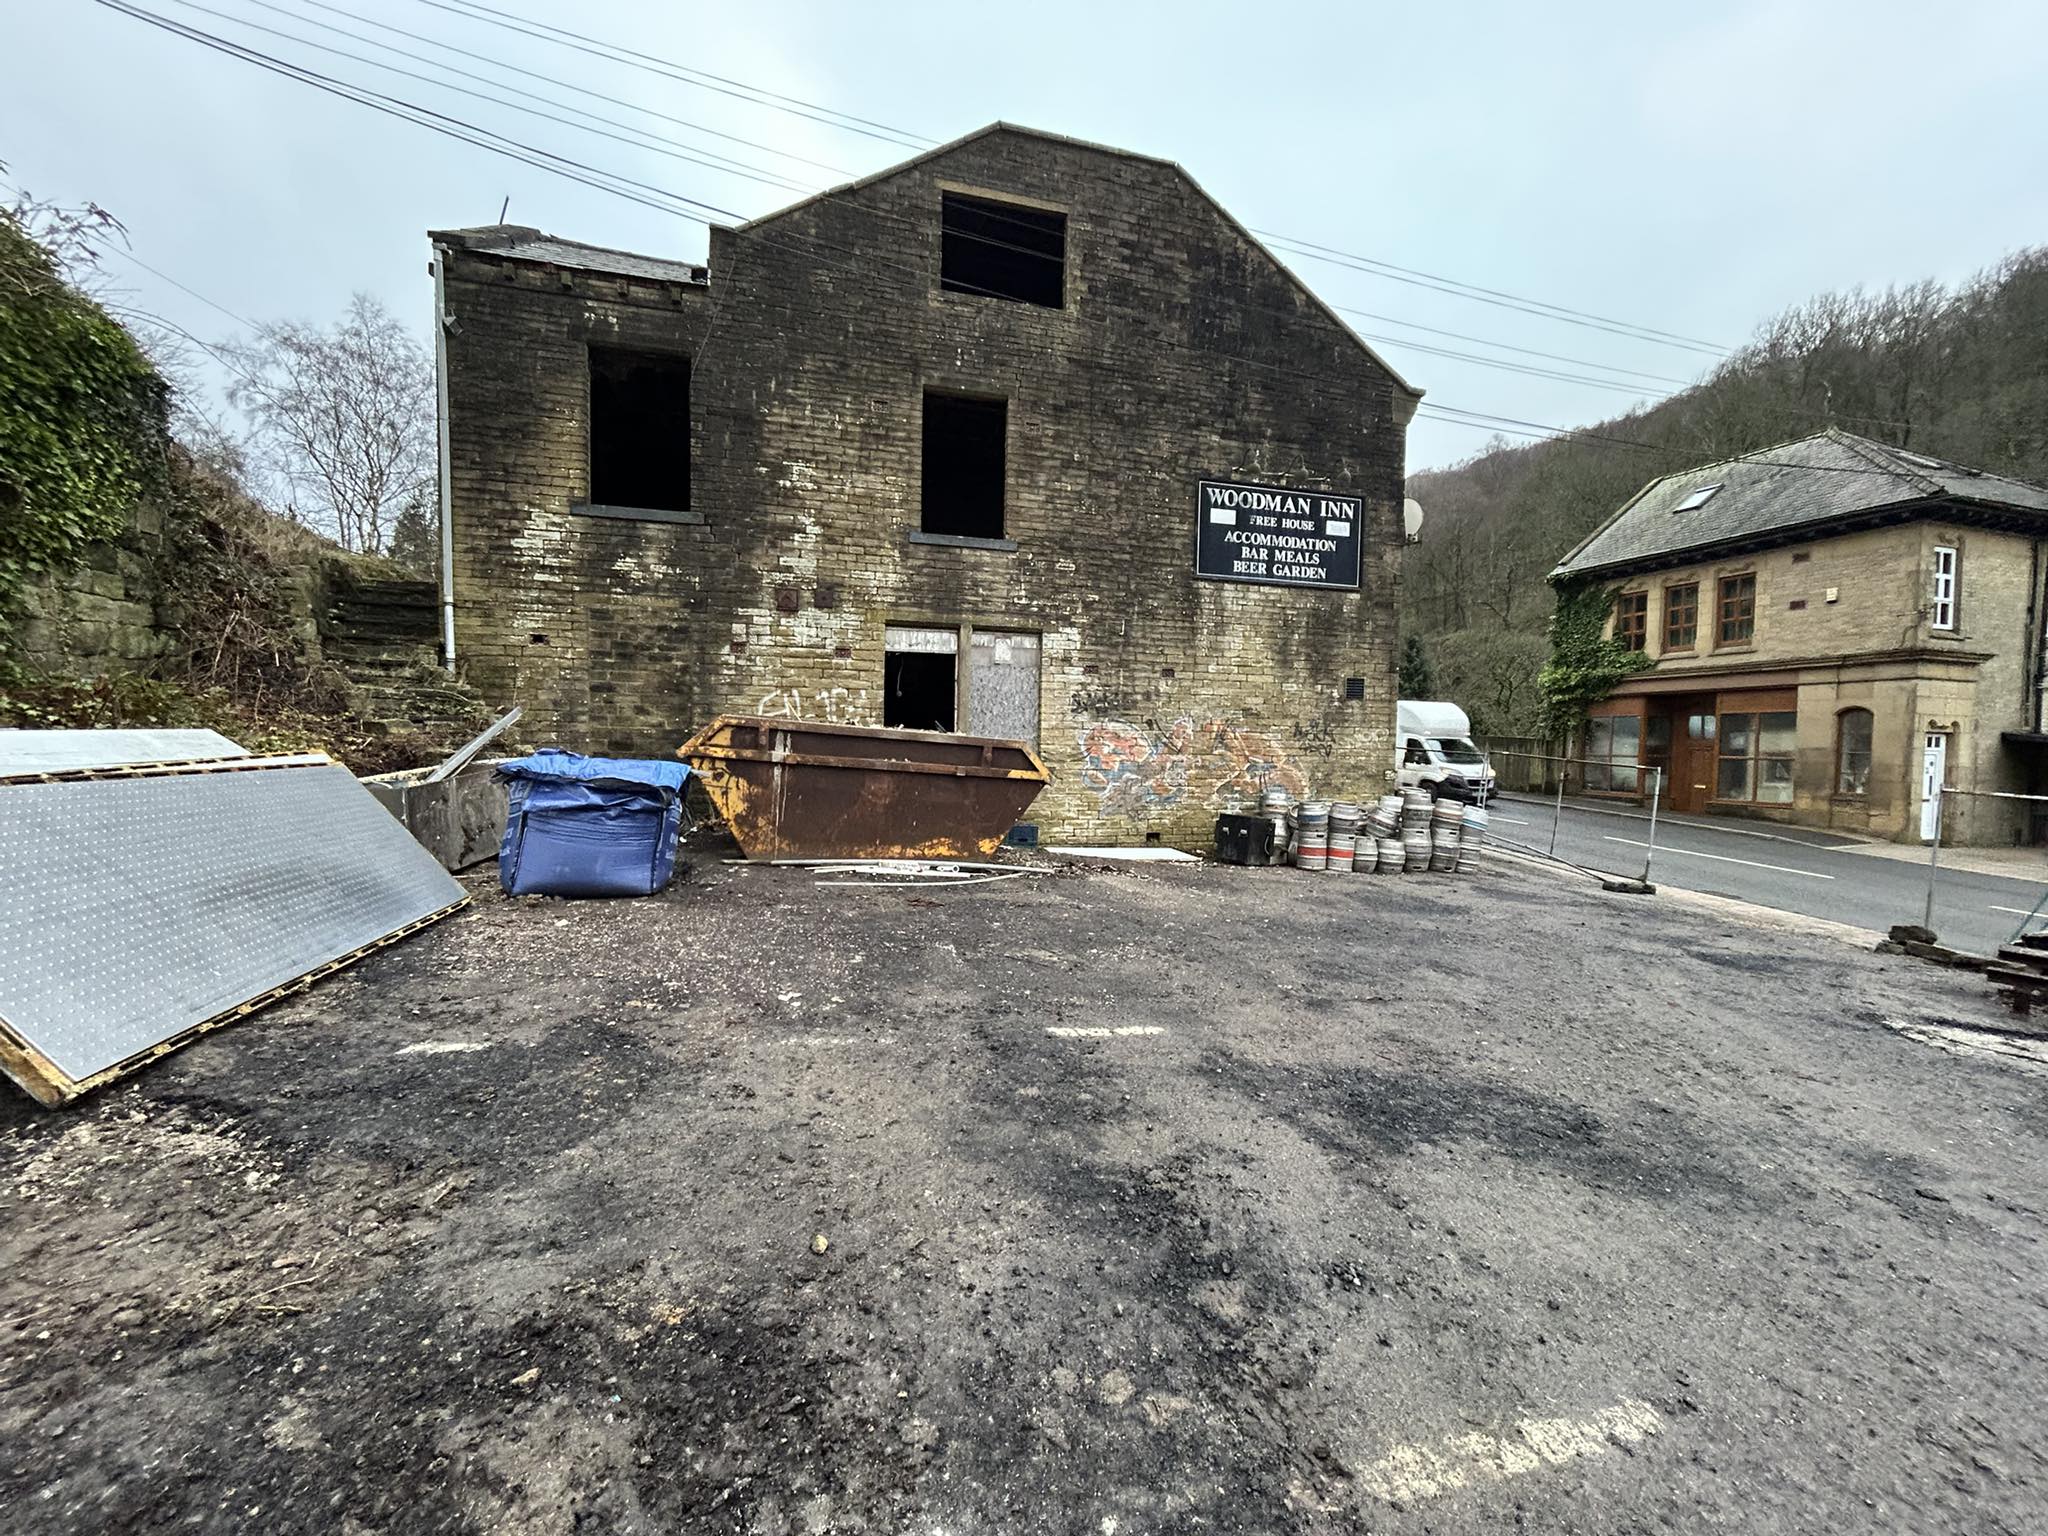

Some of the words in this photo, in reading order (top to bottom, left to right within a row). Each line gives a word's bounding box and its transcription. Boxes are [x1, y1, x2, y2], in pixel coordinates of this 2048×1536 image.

[1207, 487, 1311, 515] WOODMAN
[1320, 500, 1355, 519] INN
[1250, 515, 1278, 527] FREE
[1282, 518, 1315, 531] HOUSE
[1225, 530, 1337, 552] ACCOMMODATION
[1242, 547, 1269, 561] BAR
[1274, 550, 1320, 565] MEALS
[1233, 560, 1267, 575] BEER
[1273, 564, 1327, 579] GARDEN
